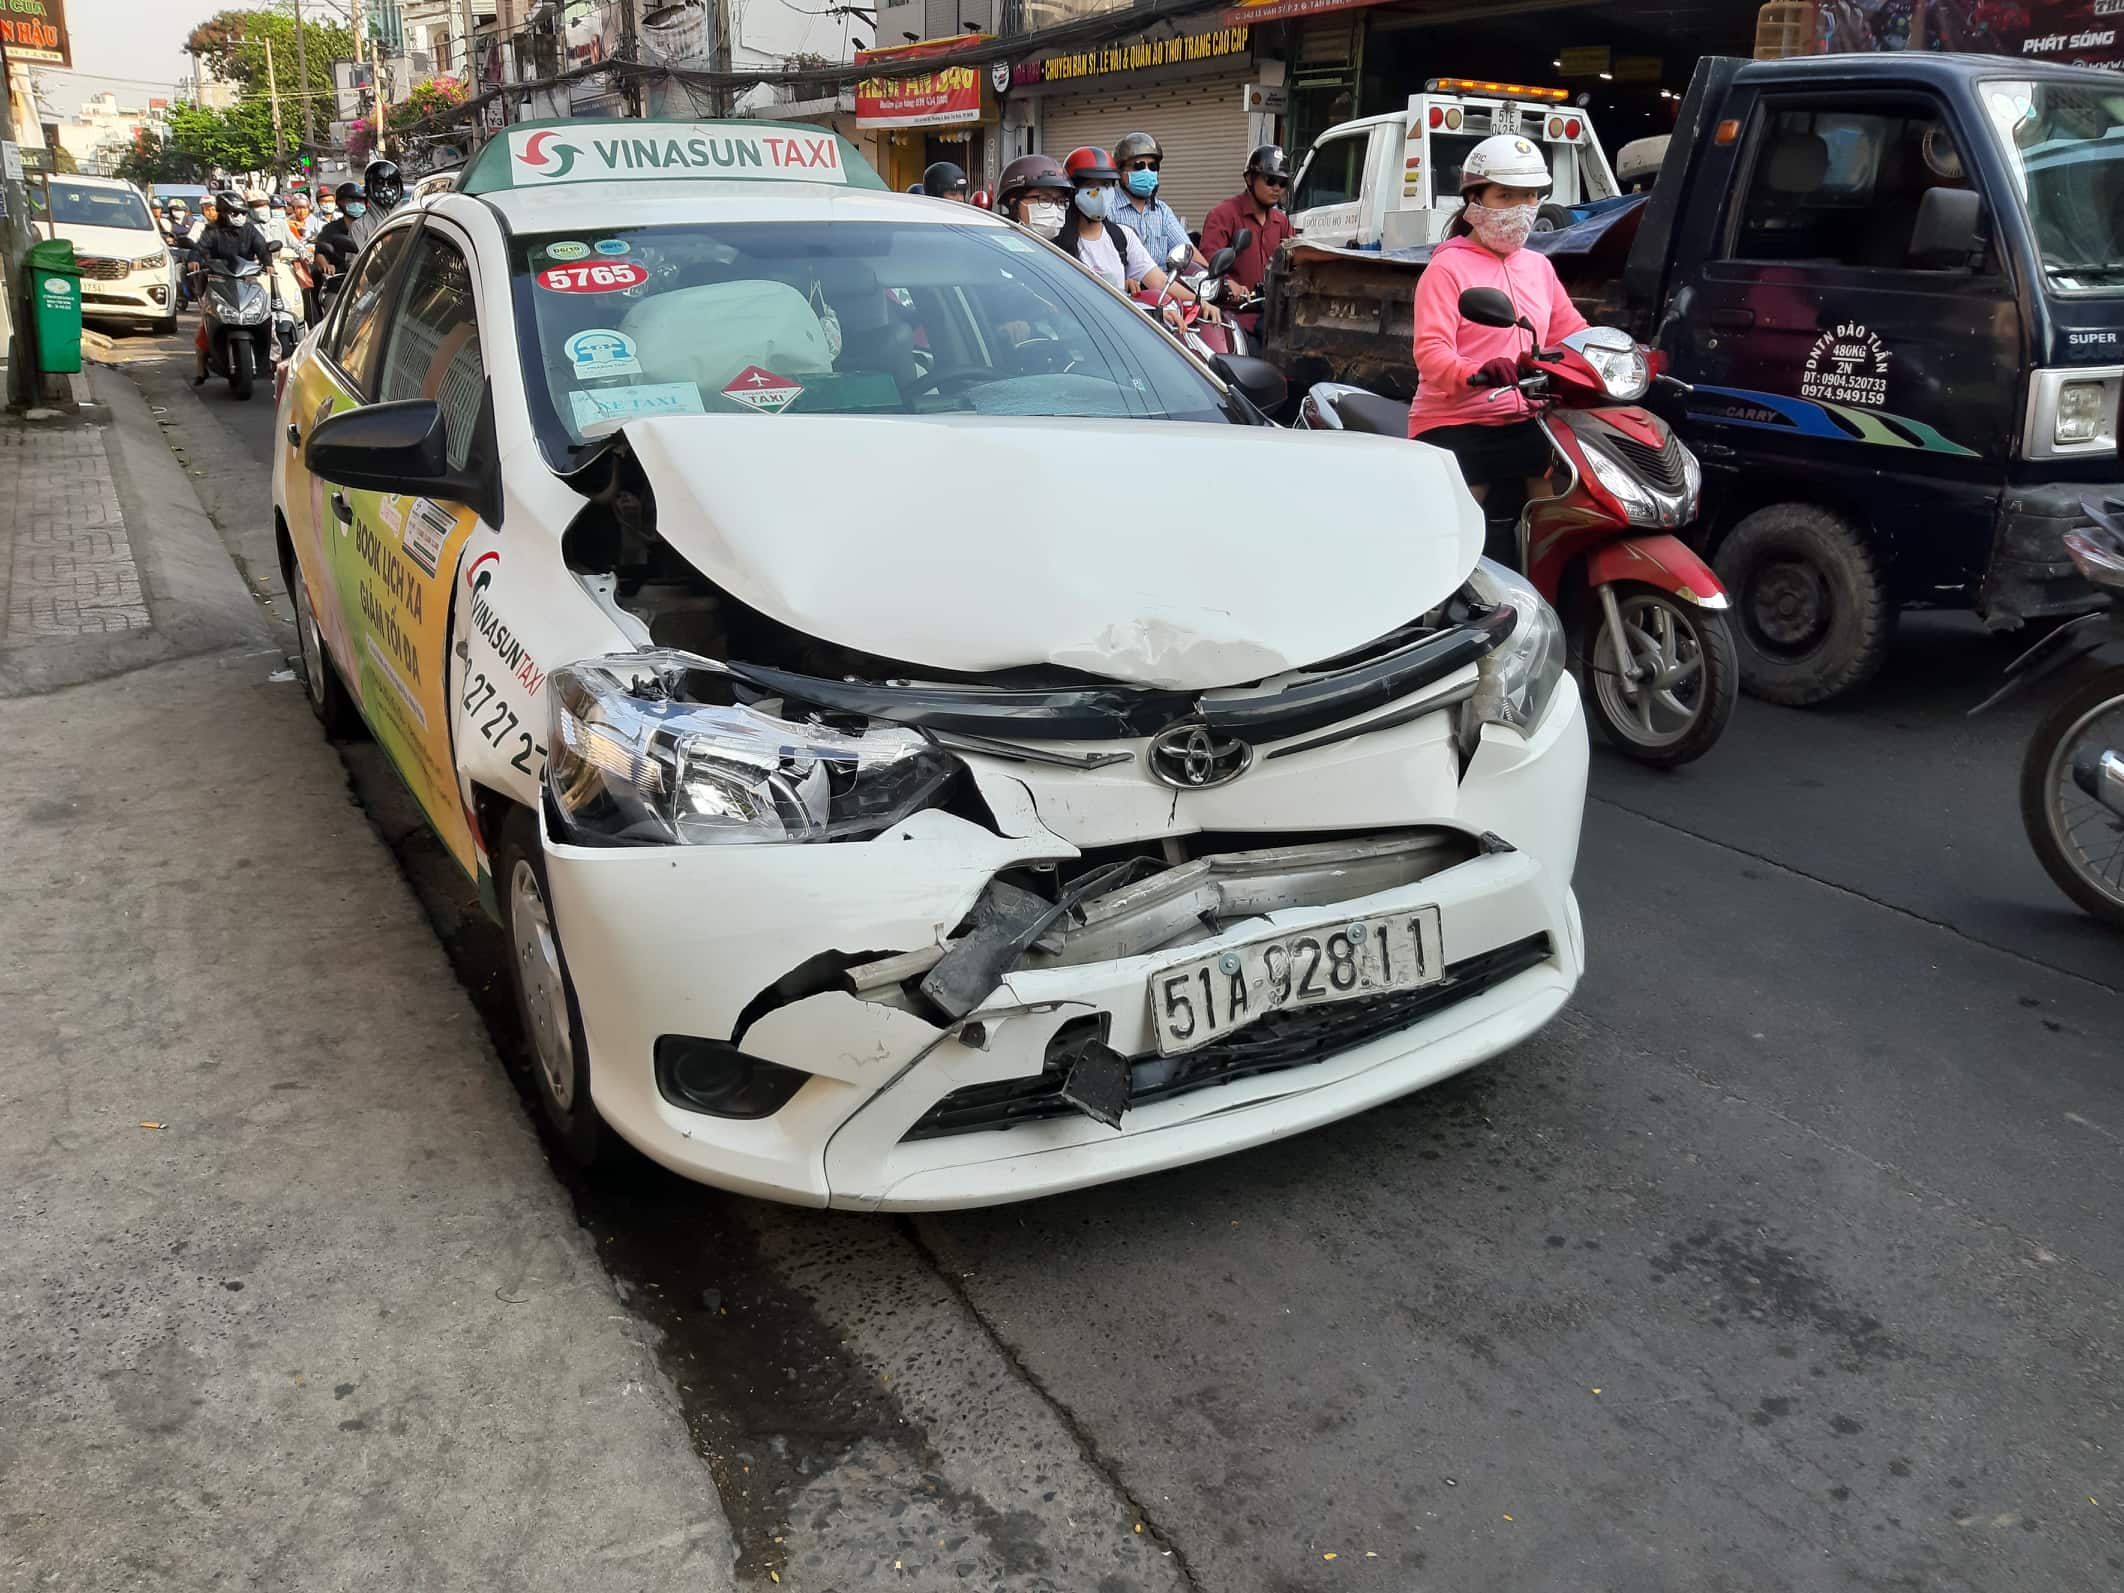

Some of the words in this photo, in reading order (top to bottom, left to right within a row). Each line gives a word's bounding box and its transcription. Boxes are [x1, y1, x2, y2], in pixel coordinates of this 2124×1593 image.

[16, 17, 57, 49] HẬU
[2022, 33, 2068, 53] PHÁT
[2068, 29, 2116, 49] SÓNG
[1152, 37, 1164, 65] ÁO
[1184, 31, 1211, 61] TRANG
[1212, 29, 1230, 57] CAO
[592, 137, 762, 169] VINASUN
[762, 137, 837, 169] TAXI
[546, 264, 637, 290] 5765
[1805, 330, 1835, 369] DNTN
[1832, 344, 1867, 358] 480KG
[2068, 332, 2117, 344] SUPER
[1836, 361, 1853, 374] 2N
[749, 393, 785, 404] TAXI
[1801, 384, 1886, 405] 0974.949159
[1725, 406, 1776, 422] CARRY
[355, 517, 381, 577] BOOK
[382, 546, 405, 603] LỊCH
[406, 571, 423, 625] XA
[359, 577, 386, 639] GIẢM
[385, 604, 402, 662] TỐI
[480, 700, 520, 749] 27
